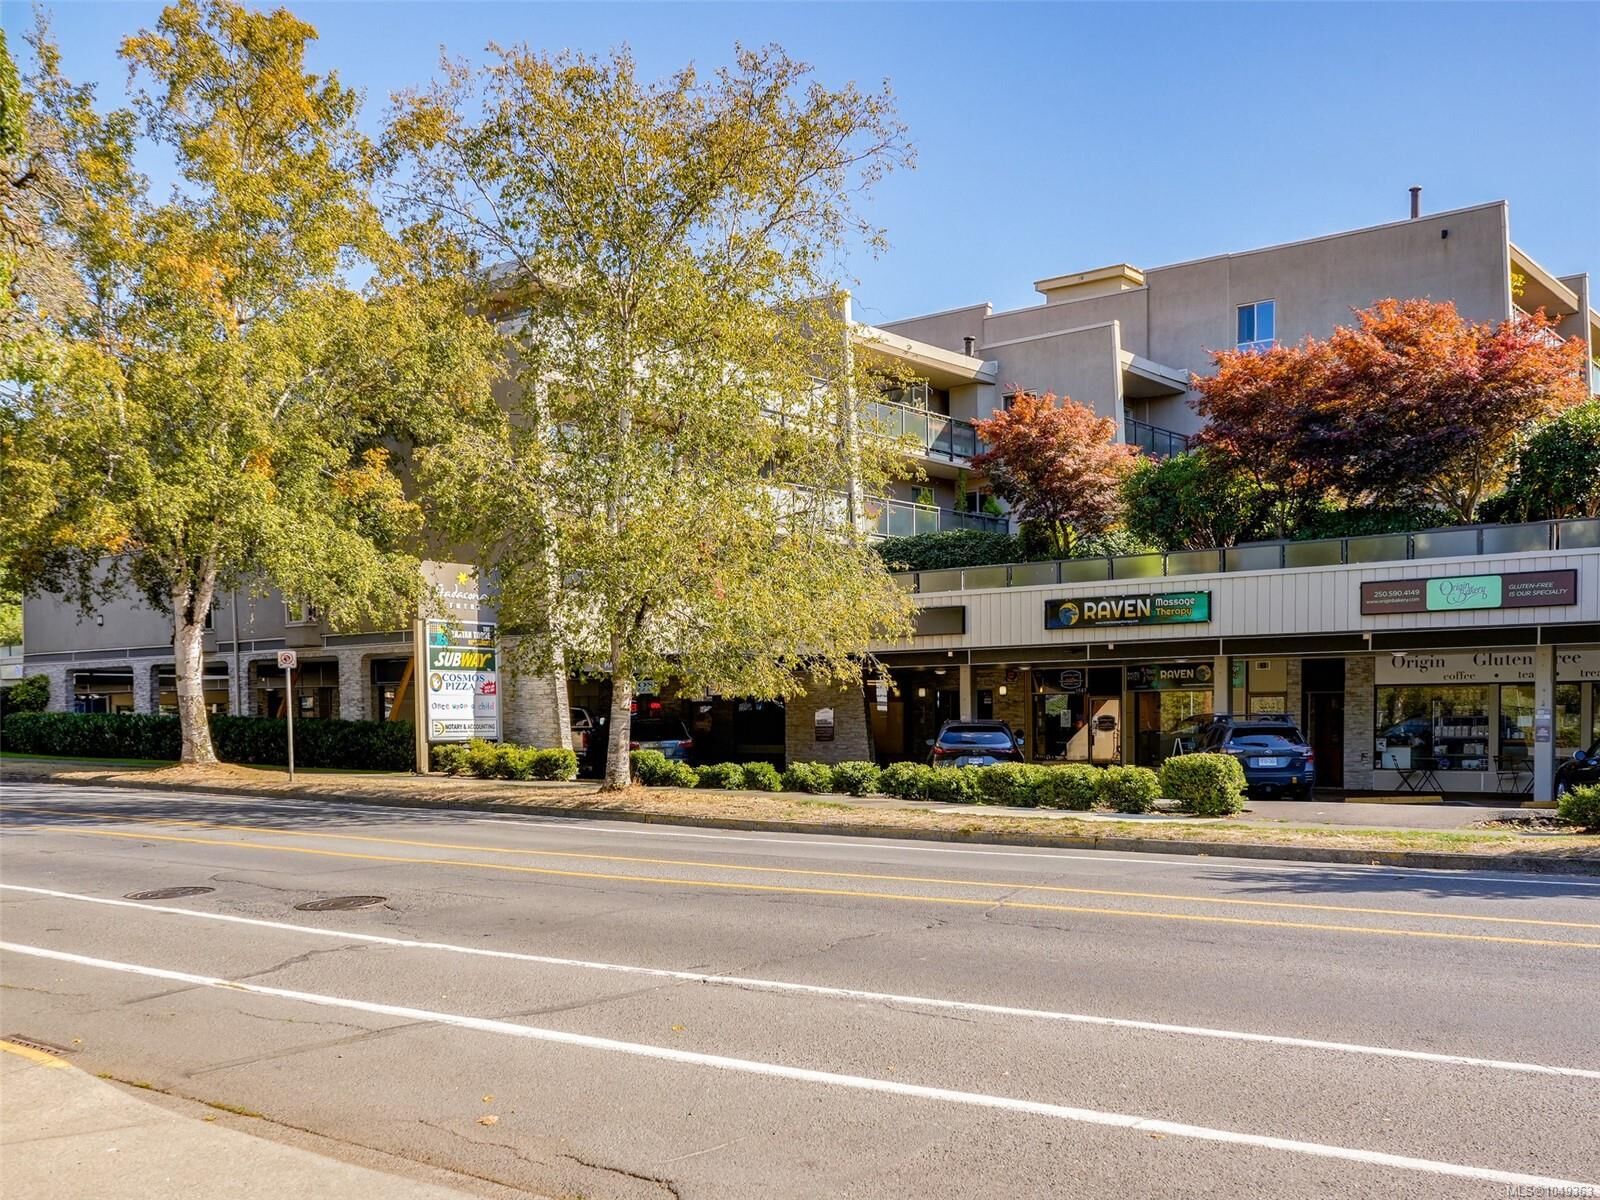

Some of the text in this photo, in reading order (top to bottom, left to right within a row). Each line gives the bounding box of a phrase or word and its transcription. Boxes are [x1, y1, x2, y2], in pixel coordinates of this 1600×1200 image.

[1439, 580, 1470, 596] Origin
[1508, 581, 1554, 590] GLUTEN-FREE
[1373, 588, 1420, 598] 250.590.4149
[1532, 588, 1568, 596] SPECIALTY
[1155, 597, 1195, 607] Massage
[1084, 598, 1151, 620] RAVEN
[1155, 607, 1192, 617] Therapy
[434, 651, 492, 668] SUBWAY
[1391, 652, 1582, 673] Origin Gluten ree
[442, 673, 486, 682] COSMOS
[1160, 669, 1194, 680] RAVEN
[1443, 669, 1600, 681] coffee tea trea
[445, 682, 476, 691] PIZZA
[431, 702, 450, 711] Once
[451, 703, 468, 712] upon
[479, 702, 496, 711] child
